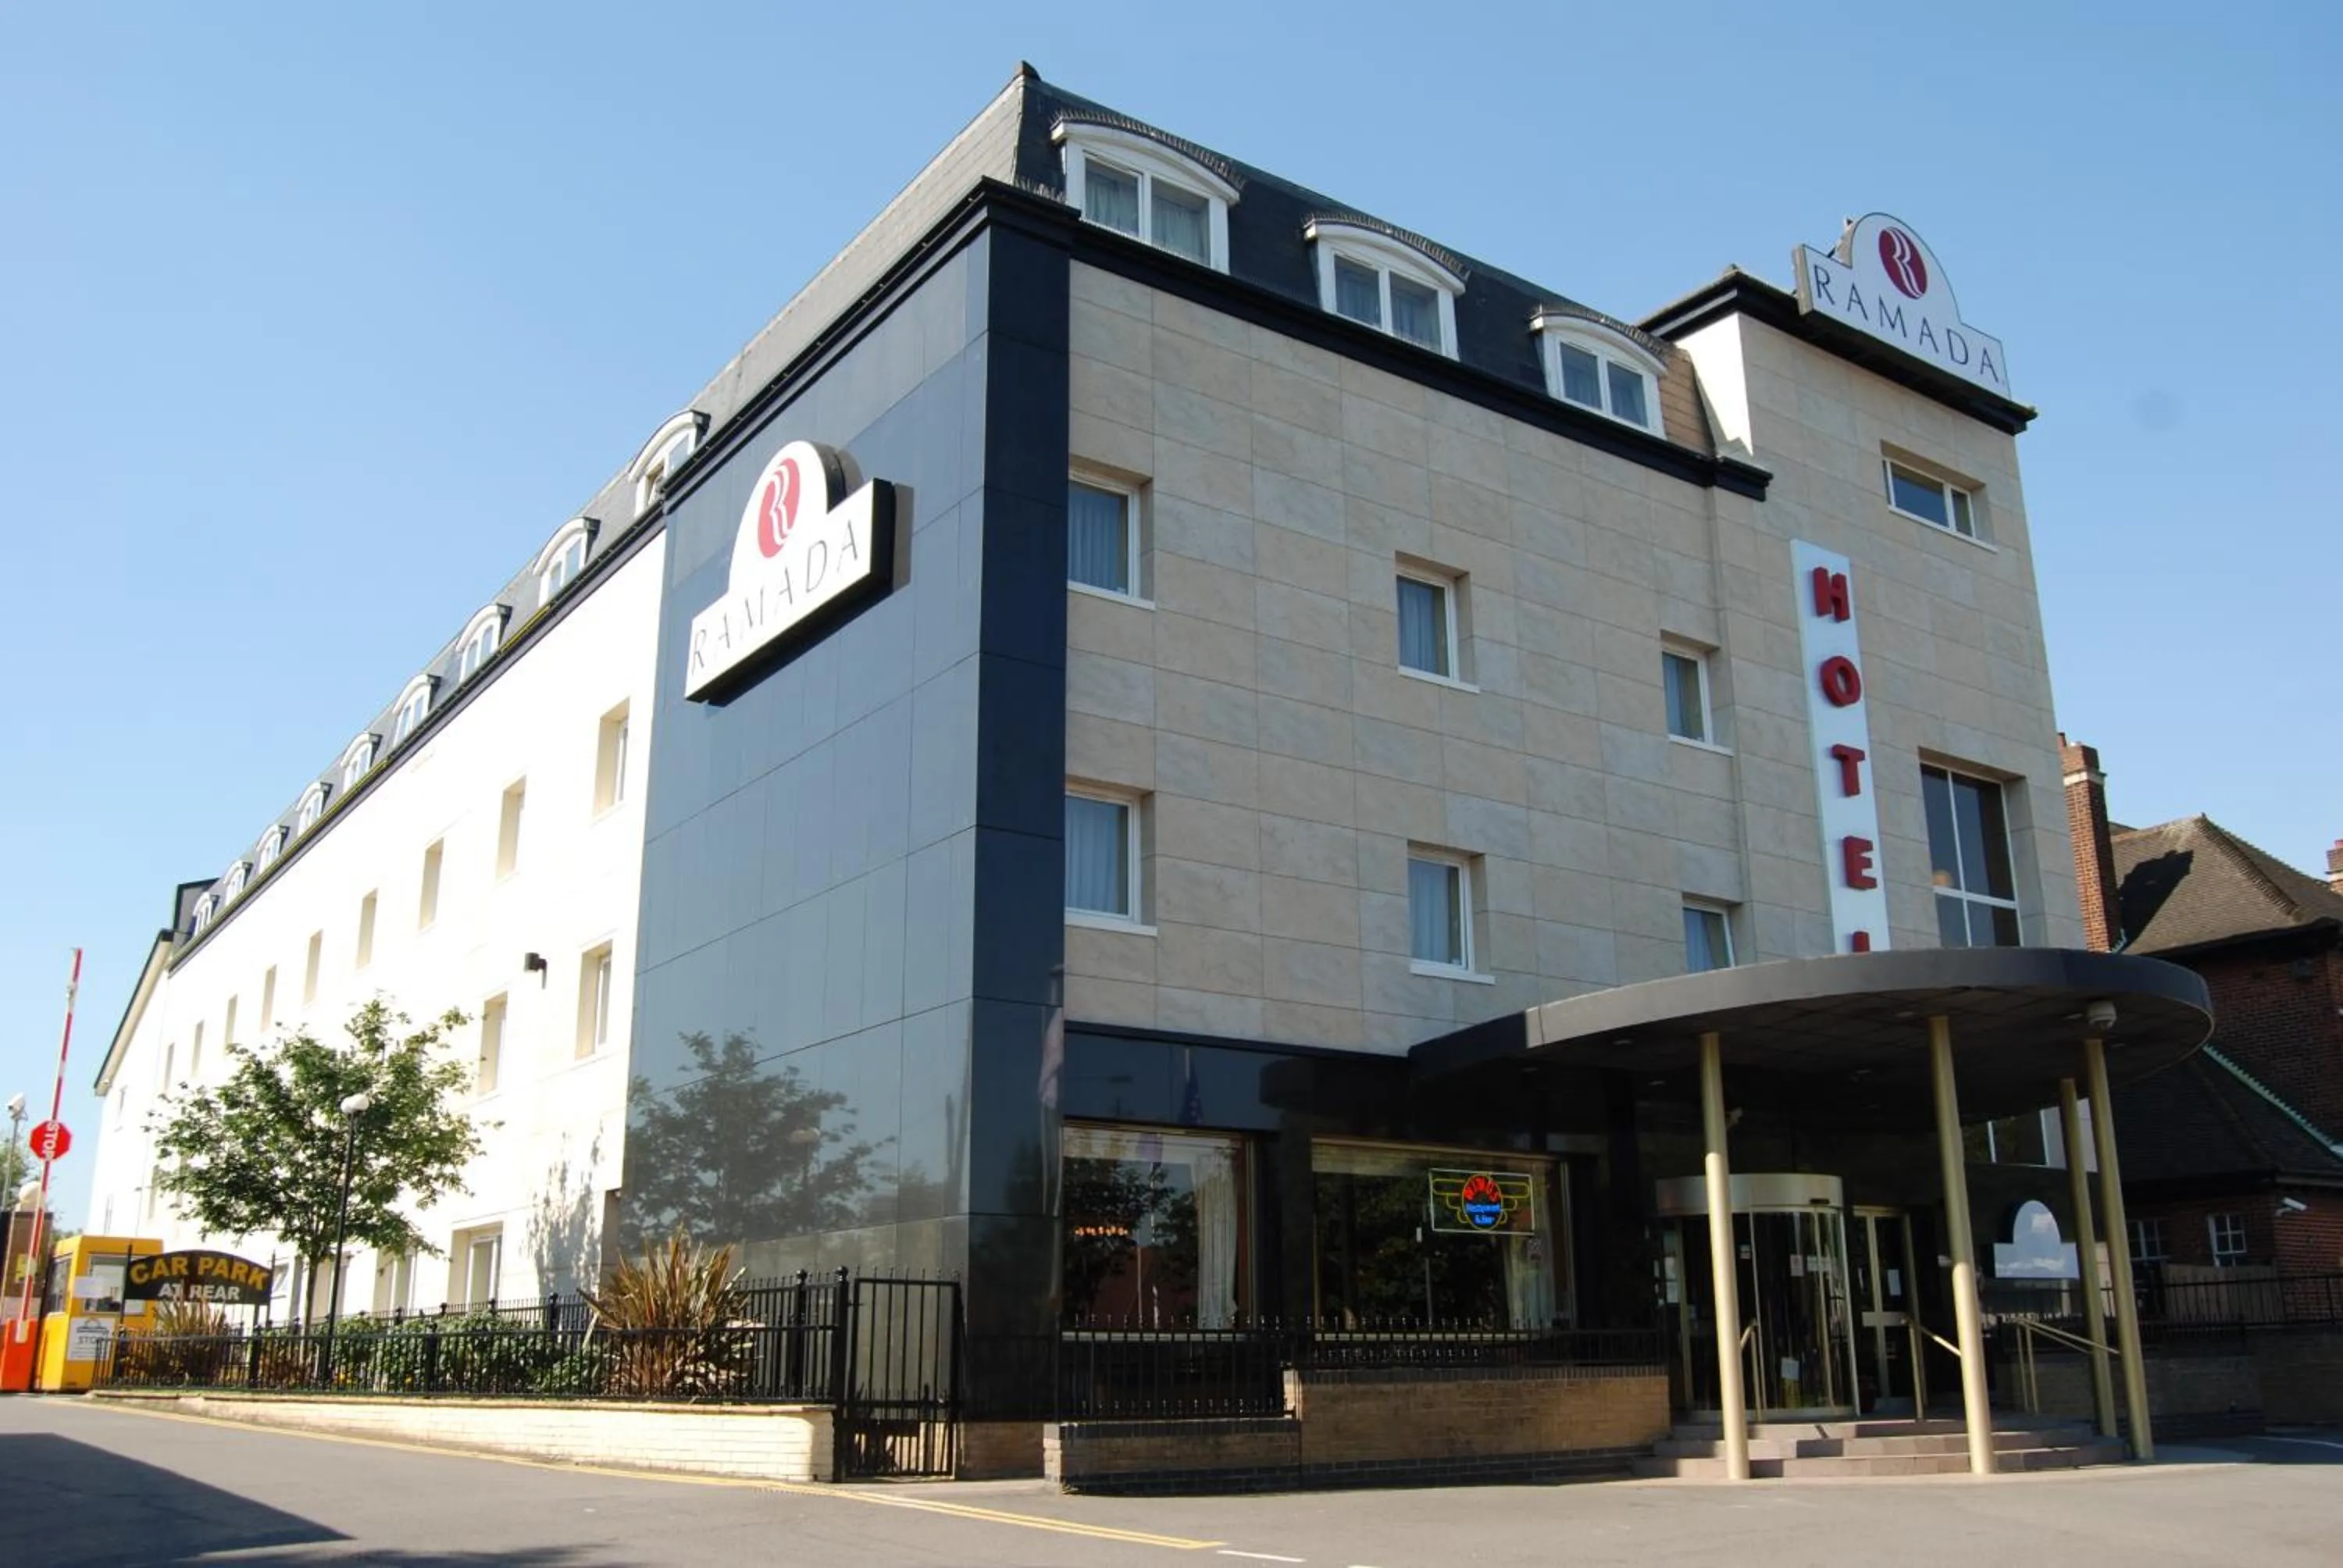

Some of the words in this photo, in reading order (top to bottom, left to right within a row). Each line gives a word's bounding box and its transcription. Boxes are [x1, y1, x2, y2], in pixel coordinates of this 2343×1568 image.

[1813, 264, 1999, 383] RAMADA
[691, 519, 858, 675] RAMADA
[41, 1121, 60, 1160] STOP
[130, 1256, 189, 1285] CAR
[198, 1256, 269, 1291] PARK
[157, 1283, 183, 1301] AT
[189, 1285, 240, 1300] REAR
